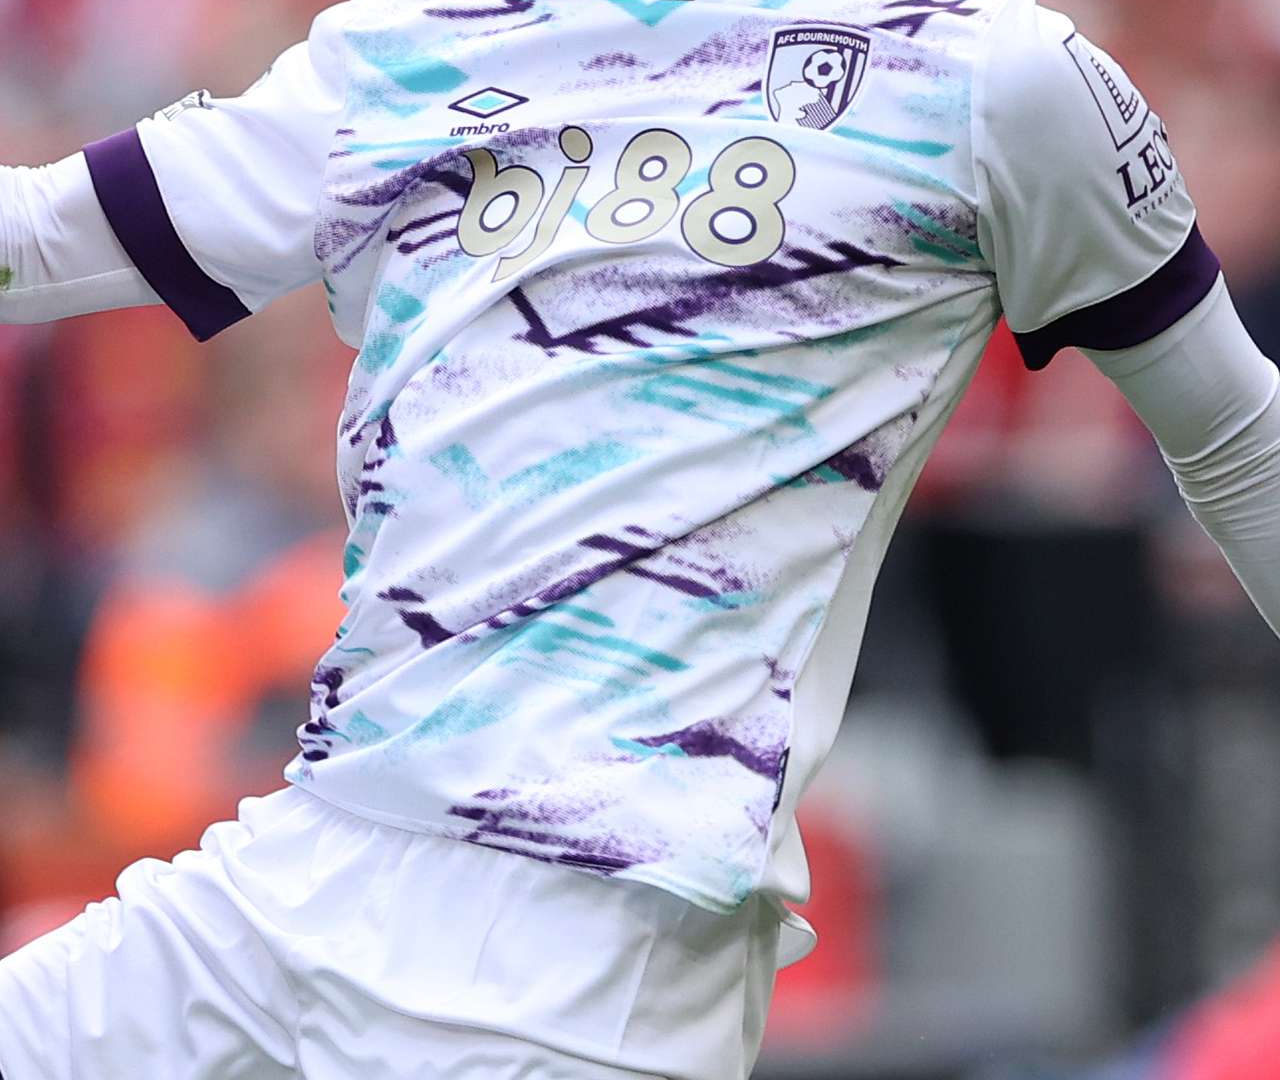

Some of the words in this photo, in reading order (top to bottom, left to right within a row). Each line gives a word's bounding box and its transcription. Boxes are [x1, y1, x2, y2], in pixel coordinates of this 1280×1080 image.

[777, 34, 796, 45] AFC
[797, 32, 868, 51] BOURNEMOUTH
[449, 123, 510, 137] umbro
[1117, 124, 1173, 208] LEO
[457, 125, 796, 283] bj88
